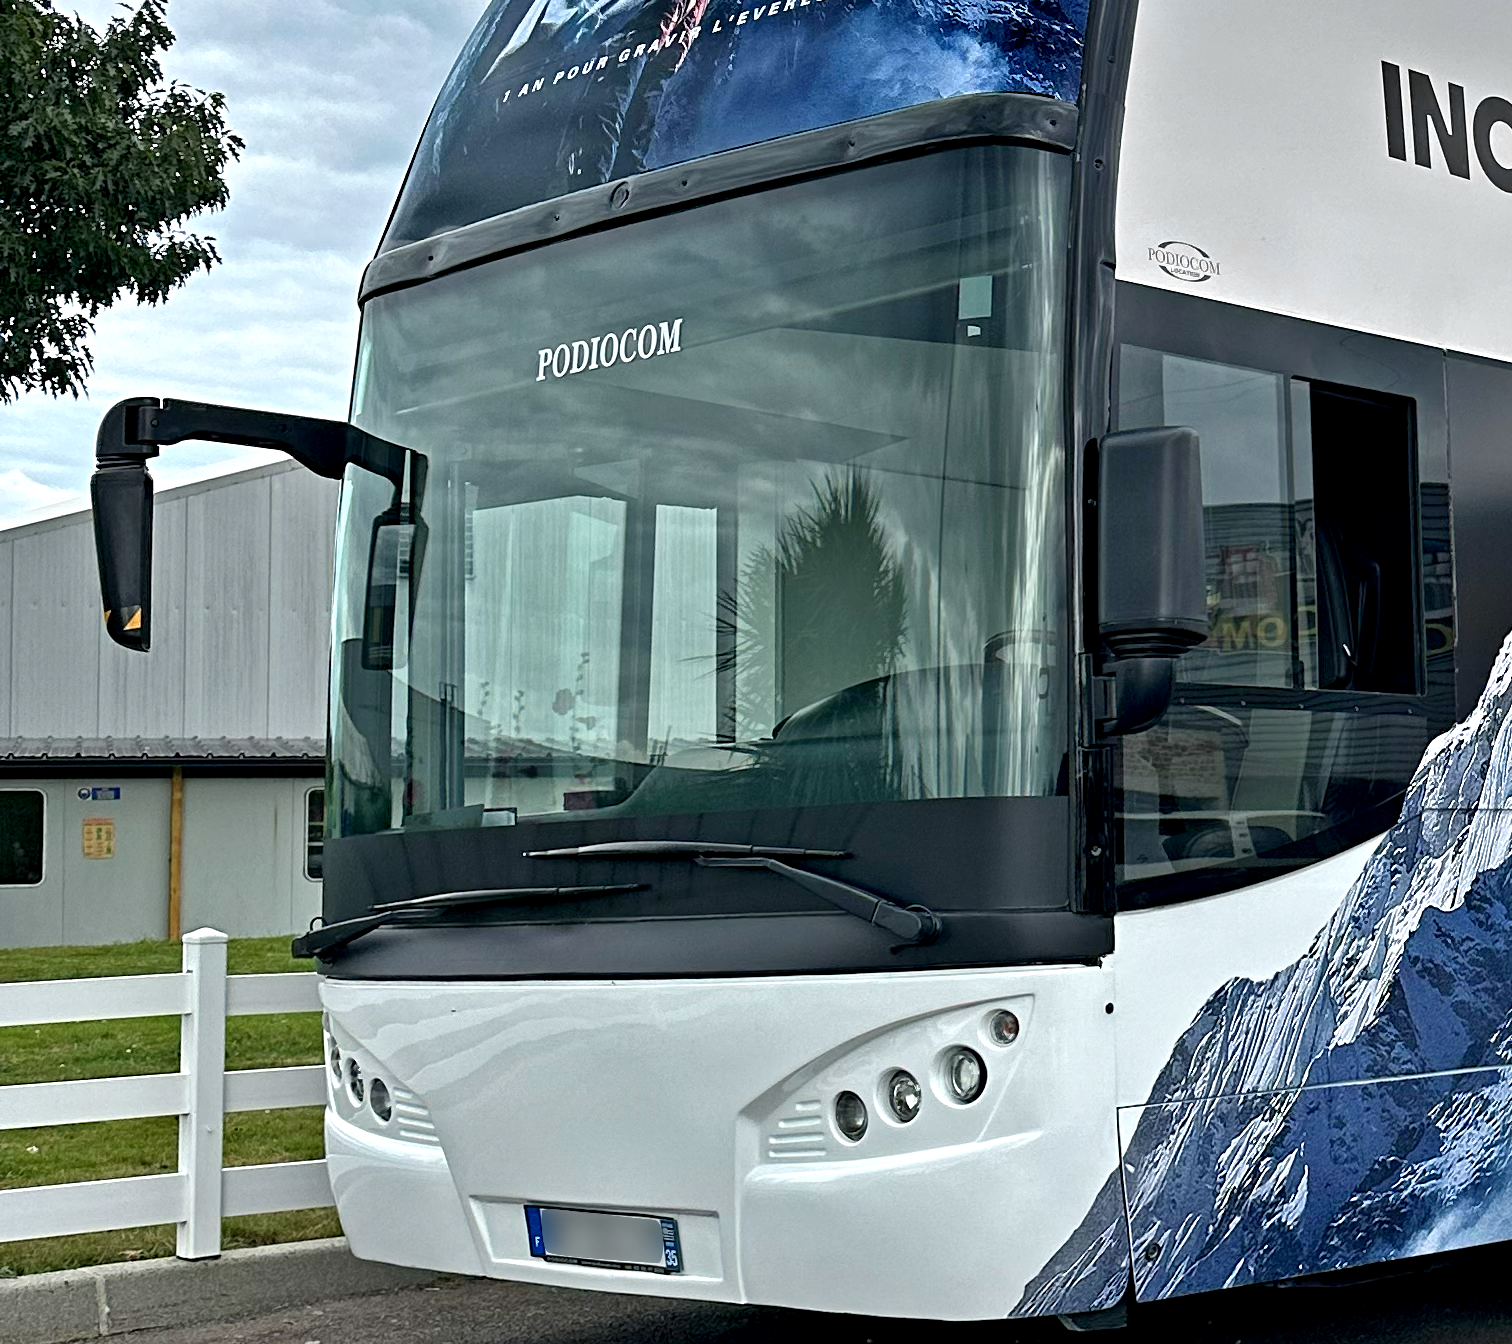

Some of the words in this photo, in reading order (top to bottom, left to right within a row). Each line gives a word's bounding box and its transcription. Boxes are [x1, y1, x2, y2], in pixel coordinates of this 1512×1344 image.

[502, 89, 512, 103] 1
[517, 78, 544, 97] AN
[552, 55, 610, 85] POUR
[618, 25, 702, 63] GRAVIR
[1147, 247, 1221, 275] PODIOCOM
[535, 318, 684, 382] PODIOCOM
[665, 1249, 679, 1267] 35
